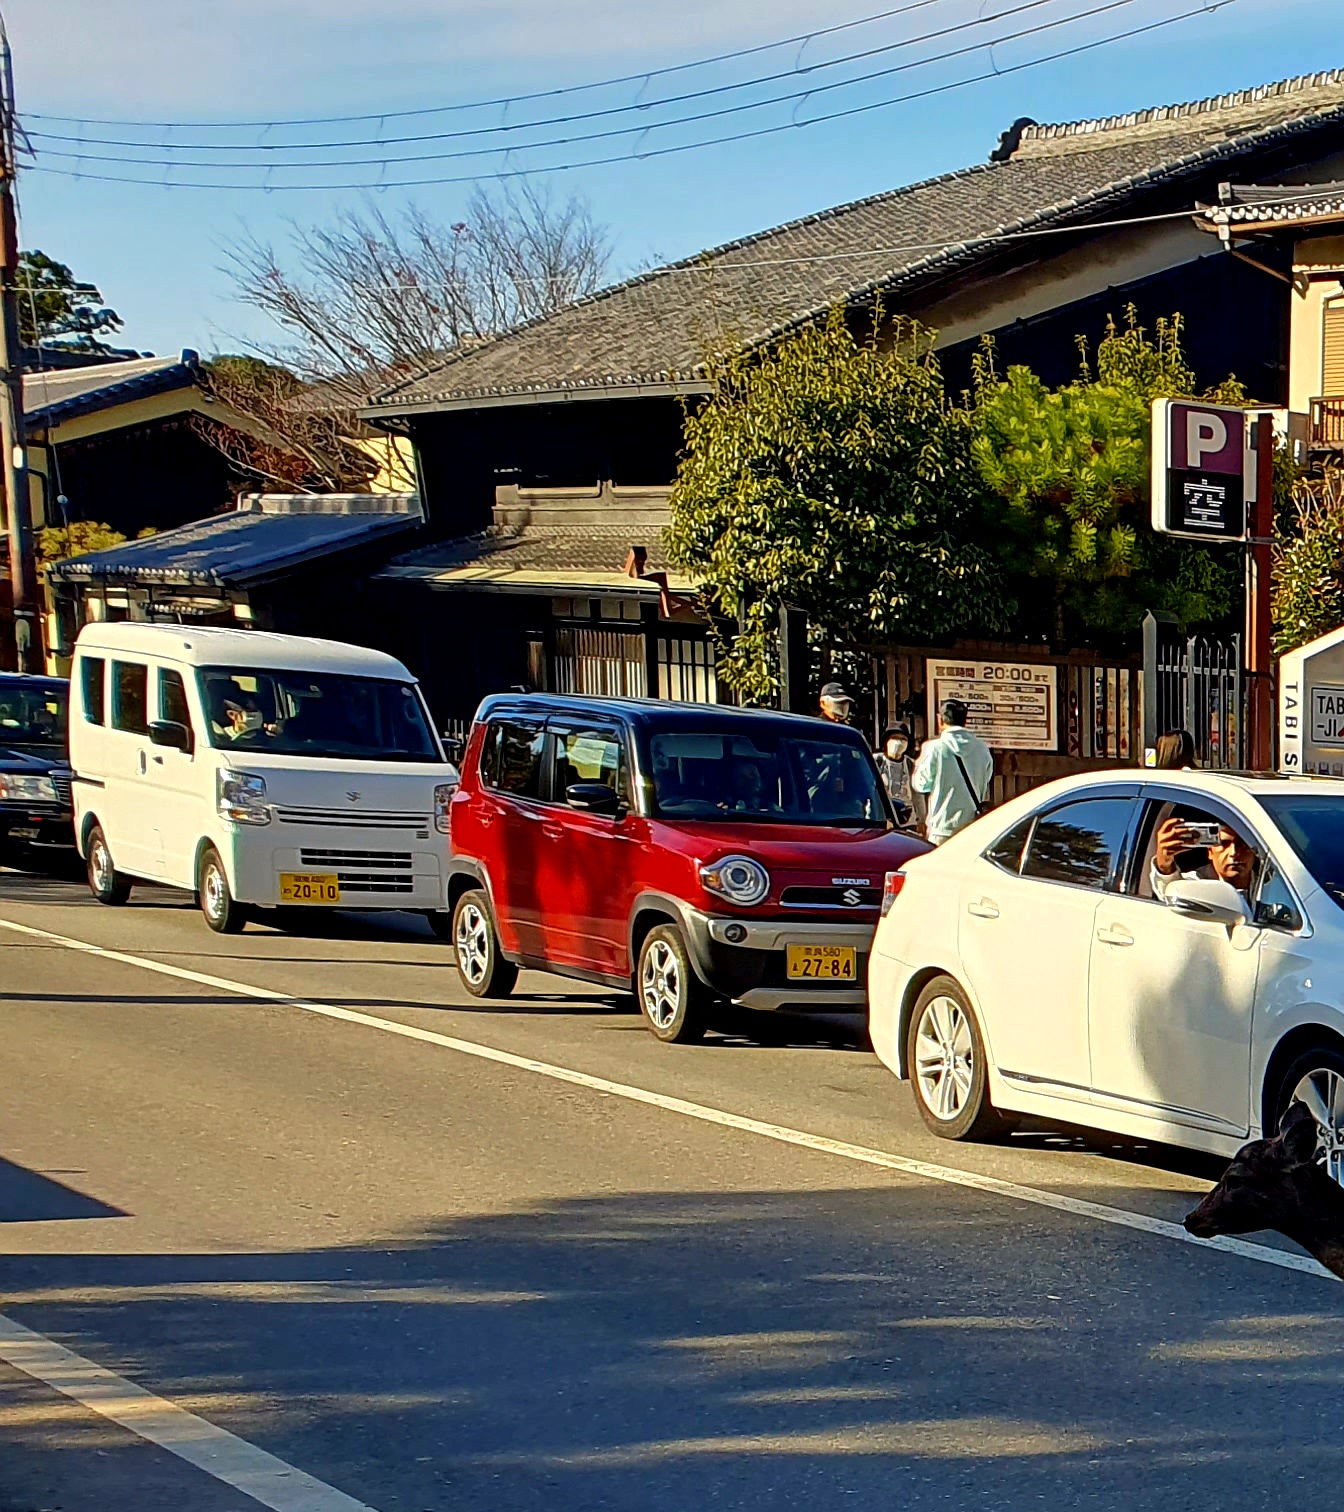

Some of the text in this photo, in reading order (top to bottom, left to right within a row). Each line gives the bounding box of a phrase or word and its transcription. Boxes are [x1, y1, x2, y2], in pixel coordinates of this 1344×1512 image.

[1186, 410, 1228, 468] P
[1184, 478, 1226, 529] 空
[983, 666, 1032, 682] 20:00
[1285, 681, 1298, 773] TABI S
[293, 884, 336, 899] 20-10
[802, 958, 851, 977] 27-84
